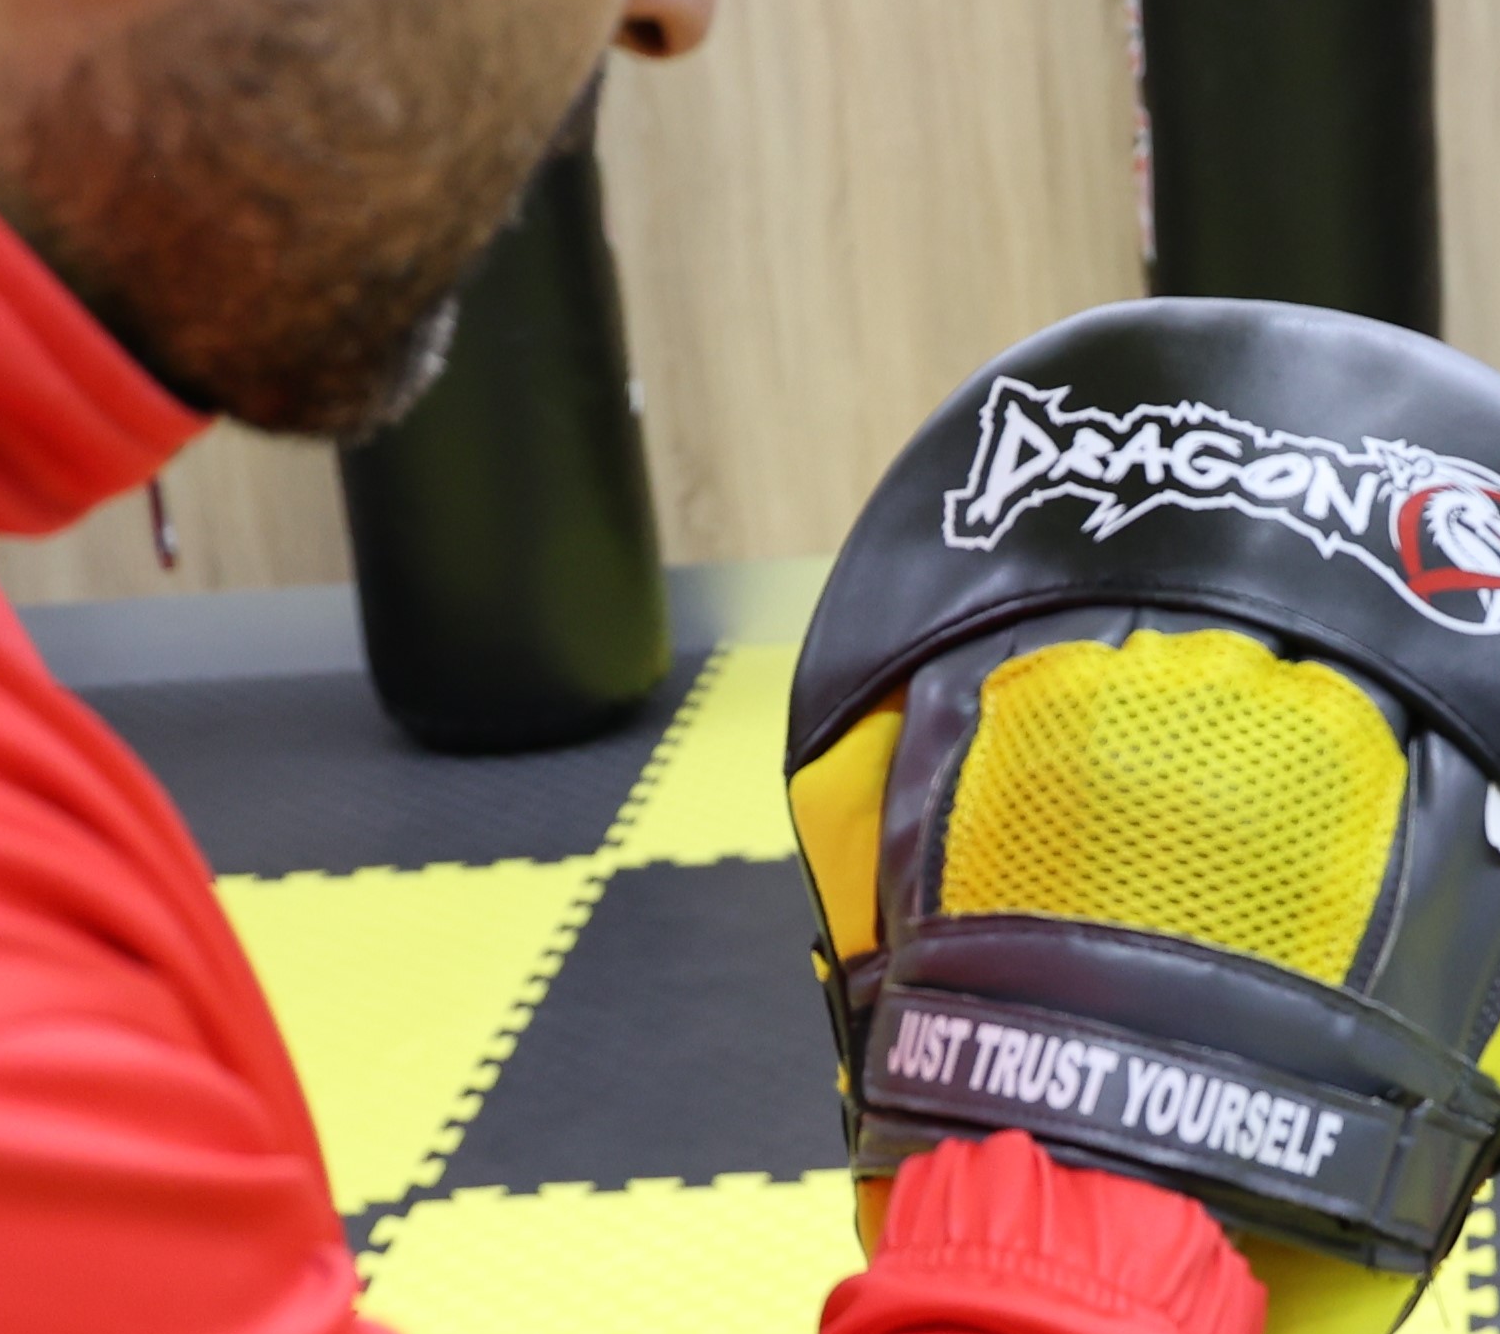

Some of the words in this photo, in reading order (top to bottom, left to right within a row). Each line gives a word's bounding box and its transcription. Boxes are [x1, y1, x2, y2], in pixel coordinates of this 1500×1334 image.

[964, 399, 1380, 536] DRAGON
[887, 1011, 972, 1085] JUST
[967, 1022, 1121, 1116] TRUST
[1120, 1056, 1345, 1179] YOURSELF
